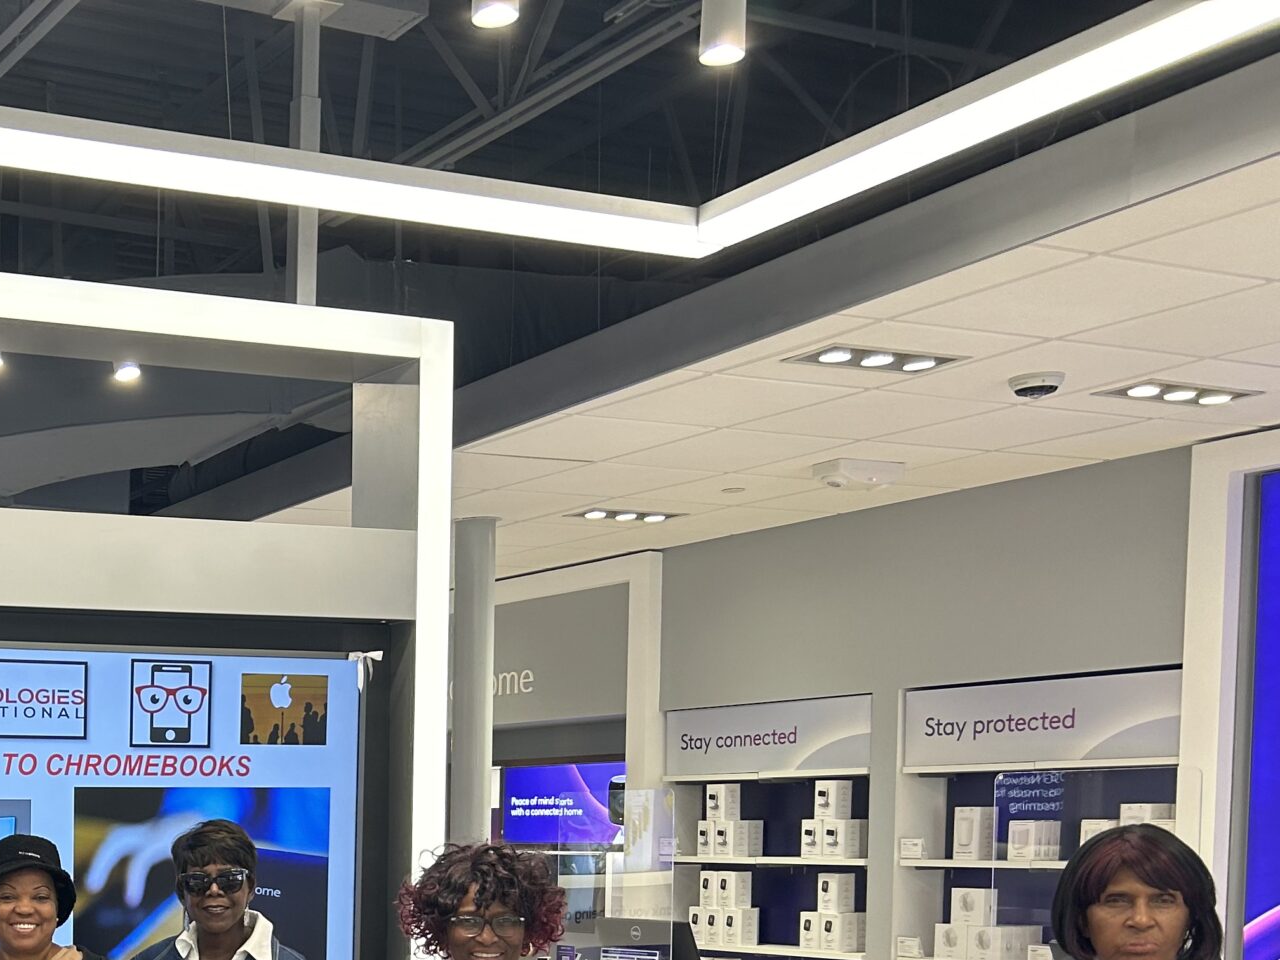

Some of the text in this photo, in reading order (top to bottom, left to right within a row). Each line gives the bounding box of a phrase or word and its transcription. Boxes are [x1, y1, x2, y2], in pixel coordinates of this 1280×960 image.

[925, 707, 1076, 742] Stay protected
[680, 725, 798, 755] Stay connected
[2, 752, 38, 776] TO
[46, 753, 252, 777] CHROMEBOOKS
[511, 796, 530, 806] Peace
[530, 796, 538, 806] of
[538, 796, 555, 806] mind
[511, 808, 525, 816] with
[530, 808, 563, 816] connected
[564, 807, 583, 816] home
[255, 886, 281, 898] ome
